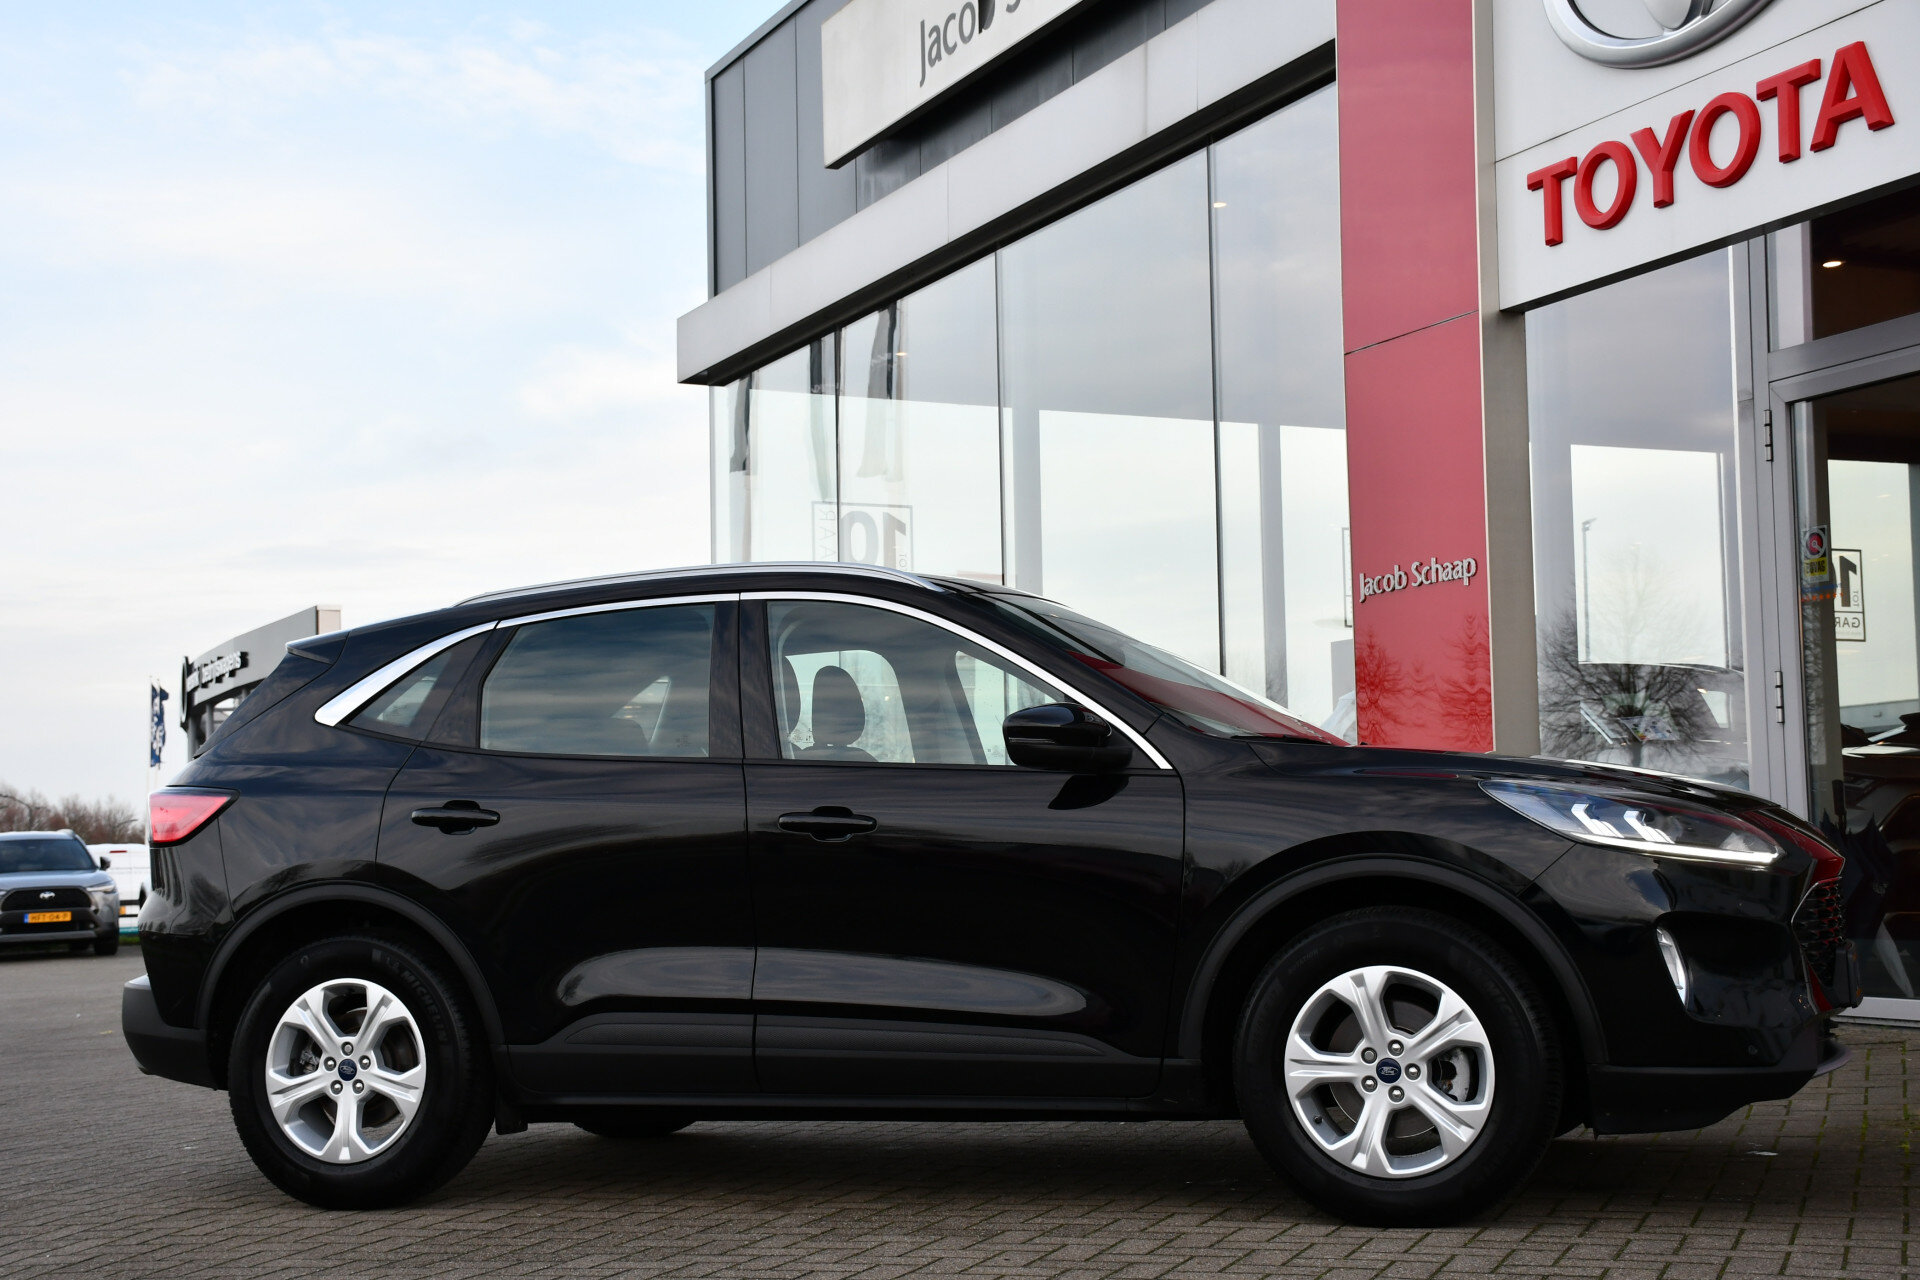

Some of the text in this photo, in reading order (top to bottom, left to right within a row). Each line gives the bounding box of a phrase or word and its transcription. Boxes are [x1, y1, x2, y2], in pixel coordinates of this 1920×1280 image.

[919, 0, 996, 88] Jaco
[1526, 40, 1895, 247] TOYOTA
[1359, 557, 1477, 604] Jacob Schaap
